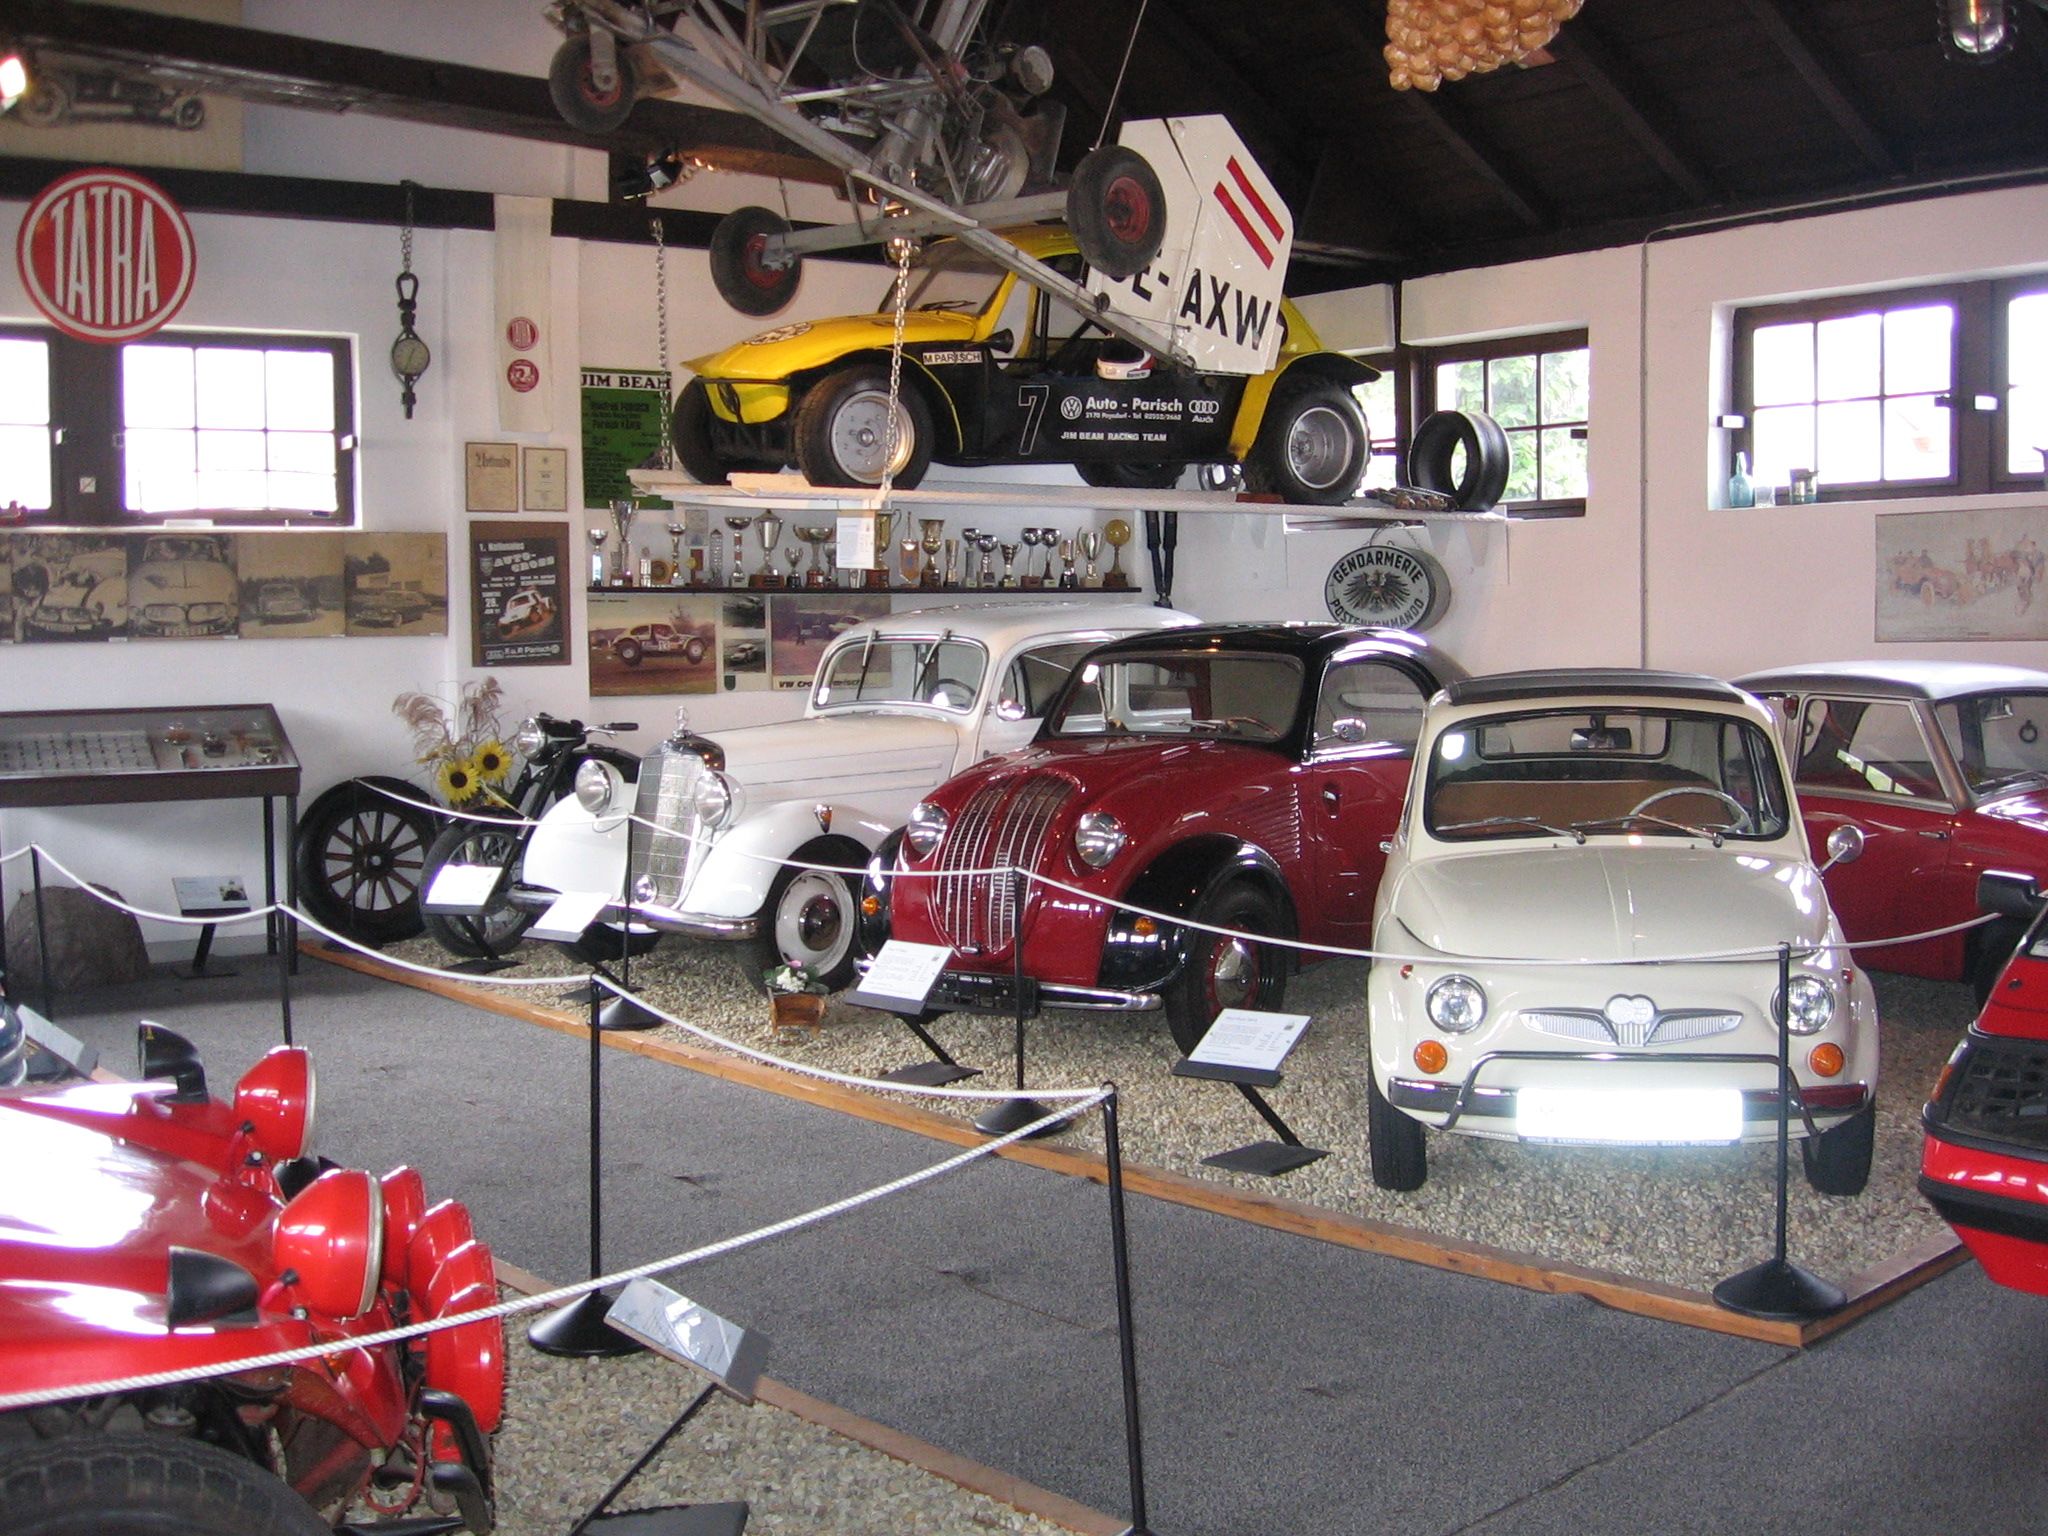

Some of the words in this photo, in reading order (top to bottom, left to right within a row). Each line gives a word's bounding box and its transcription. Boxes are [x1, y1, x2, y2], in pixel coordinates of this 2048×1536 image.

[51, 186, 158, 326] TATRA
[934, 352, 981, 363] PARISCH
[581, 374, 611, 387] JIM
[1085, 396, 1118, 410] Auto
[1132, 397, 1183, 412] Parisch
[1018, 385, 1049, 455] 7
[1060, 431, 1077, 440] JIM
[1079, 432, 1104, 440] BEAM
[1107, 432, 1140, 441] RACING
[1142, 433, 1168, 442] TEAM
[1332, 550, 1424, 584] GENDARMERIE
